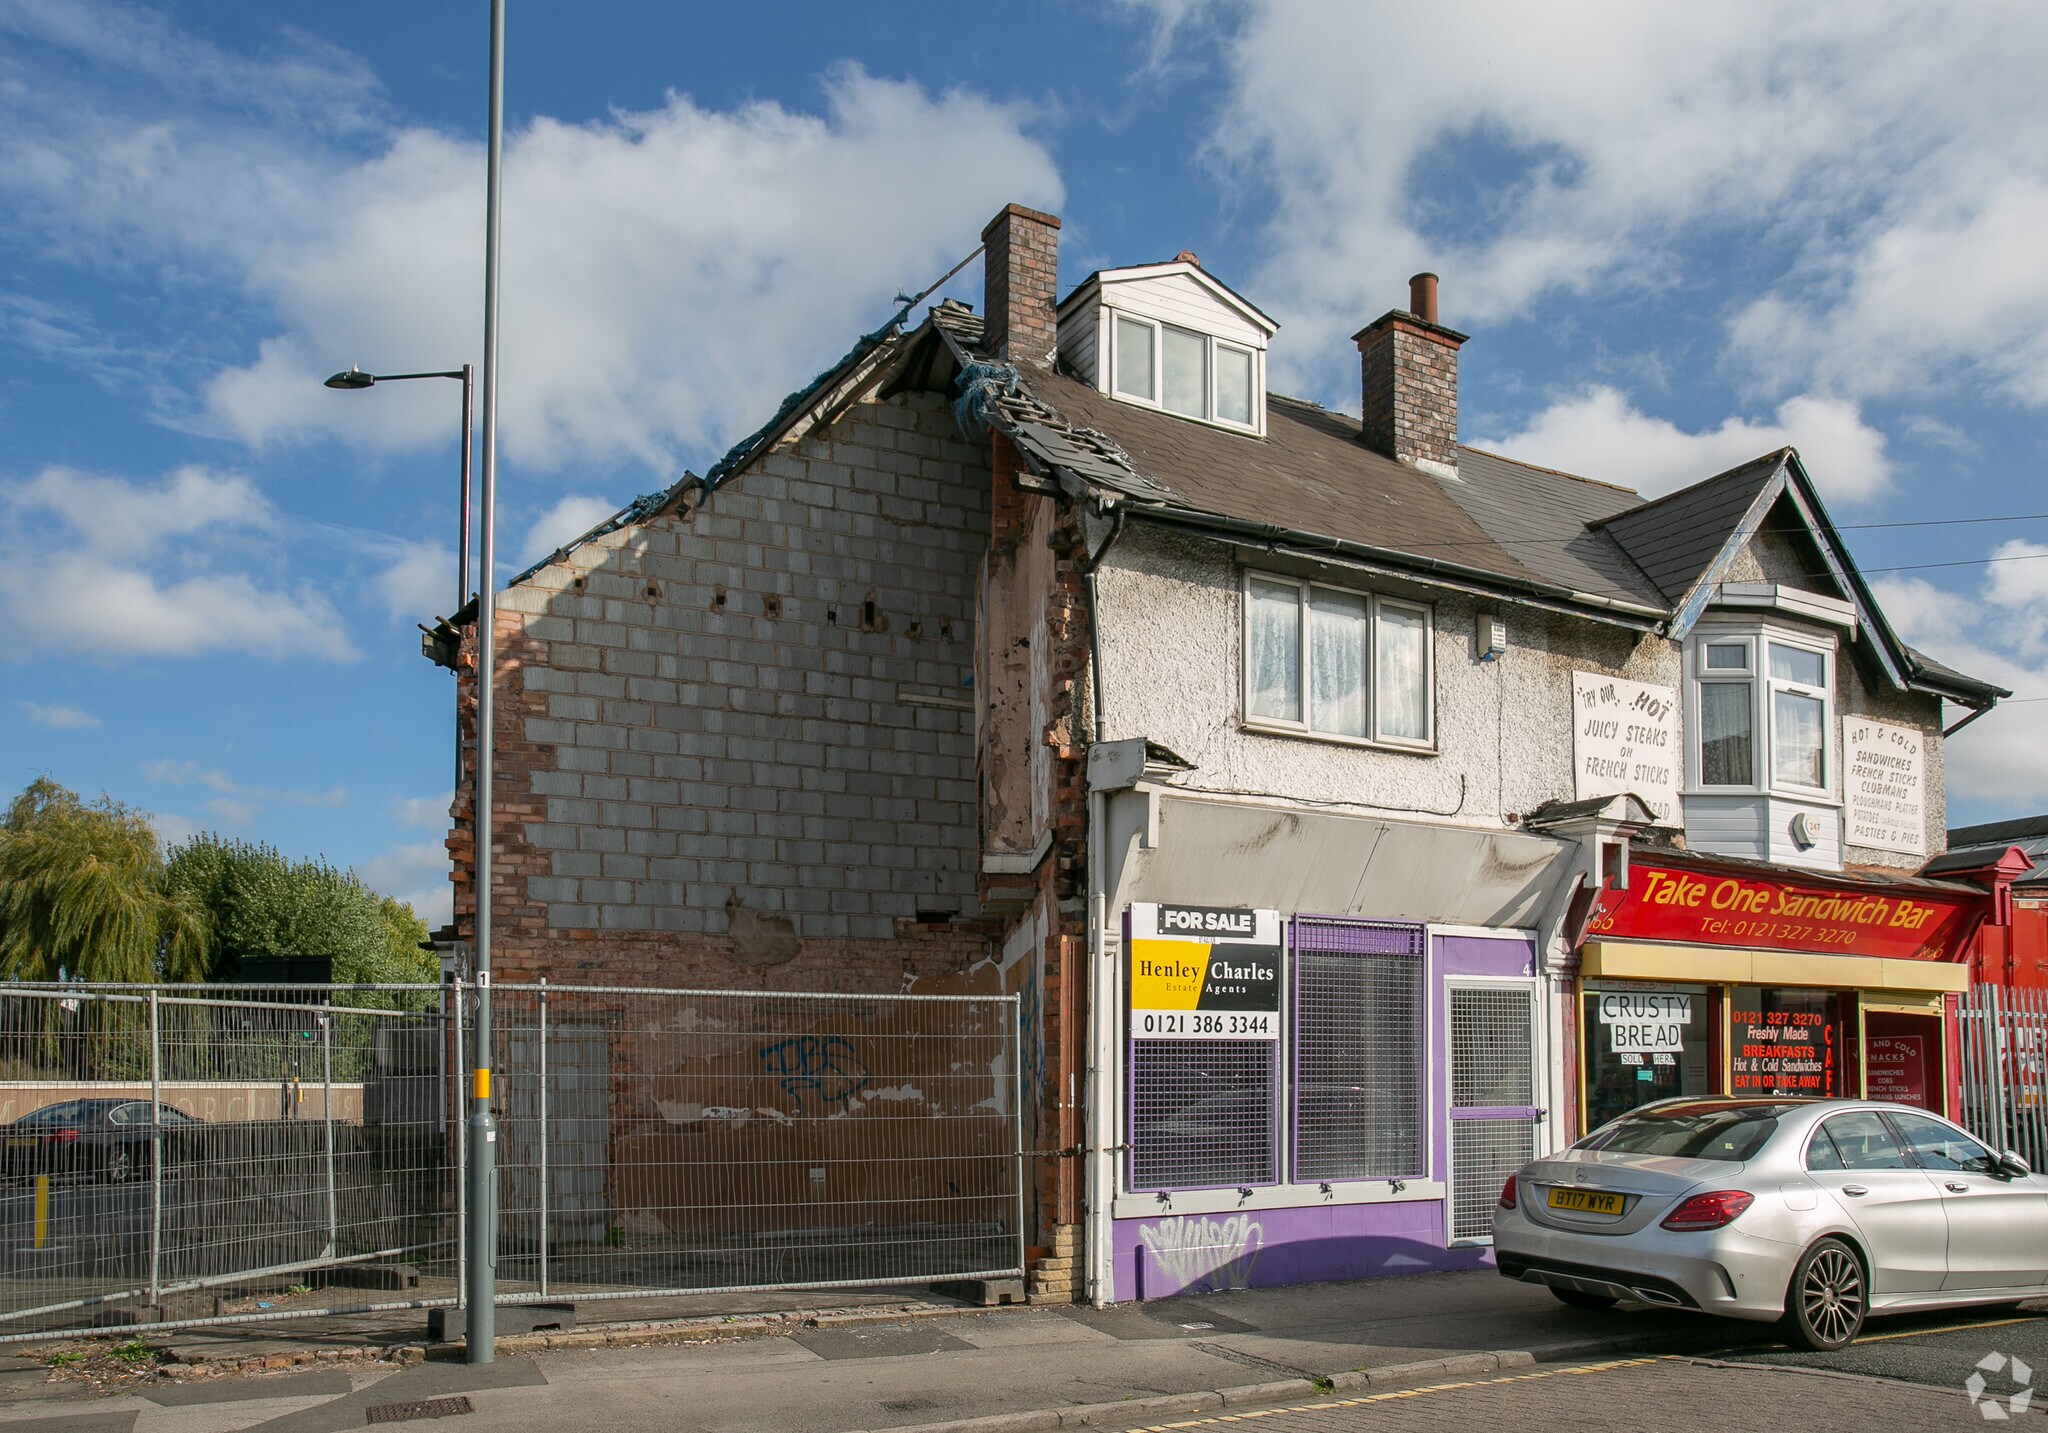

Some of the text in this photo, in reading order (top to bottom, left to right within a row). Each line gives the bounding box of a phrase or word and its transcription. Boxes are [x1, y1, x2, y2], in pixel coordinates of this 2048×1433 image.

[1582, 684, 1670, 722] TRY OUR HOT
[1584, 719, 1667, 747] JUICY STEAKS
[1852, 728, 1917, 755] HOT & COLD
[1856, 750, 1912, 771] SANDWICHES
[1586, 757, 1670, 785] FRENCH STICKS
[1851, 765, 1918, 787] FRENCH STICKS
[1861, 781, 1908, 800] CLUBMANS
[1854, 825, 1920, 845] PASTIES & PIES
[1642, 871, 1934, 929] Take One Sandwich Bar
[1164, 910, 1251, 932] FOR SALE
[1701, 917, 1732, 934] Tel:
[1813, 928, 1857, 945] 3270
[1140, 960, 1274, 983] Henley Charles
[1166, 982, 1246, 995] Estate Agents
[1603, 996, 1689, 1018] CRUSTY
[1144, 1015, 1268, 1034] 0121 386 3344
[1733, 1011, 1822, 1026] 0121 327 3270
[1615, 1025, 1679, 1046] BREAD
[1747, 1025, 1808, 1042] Freshly Made
[1742, 1044, 1815, 1058] BREAKFASTS
[1873, 1040, 1917, 1057] AND COLD
[1622, 1054, 1674, 1064] SOLD HERE
[1733, 1057, 1822, 1072] Hot & Cold Sandwiches
[1734, 1075, 1820, 1088] EAT IN OR TAKE AWAY
[1555, 1191, 1615, 1211] BT17 WYR
